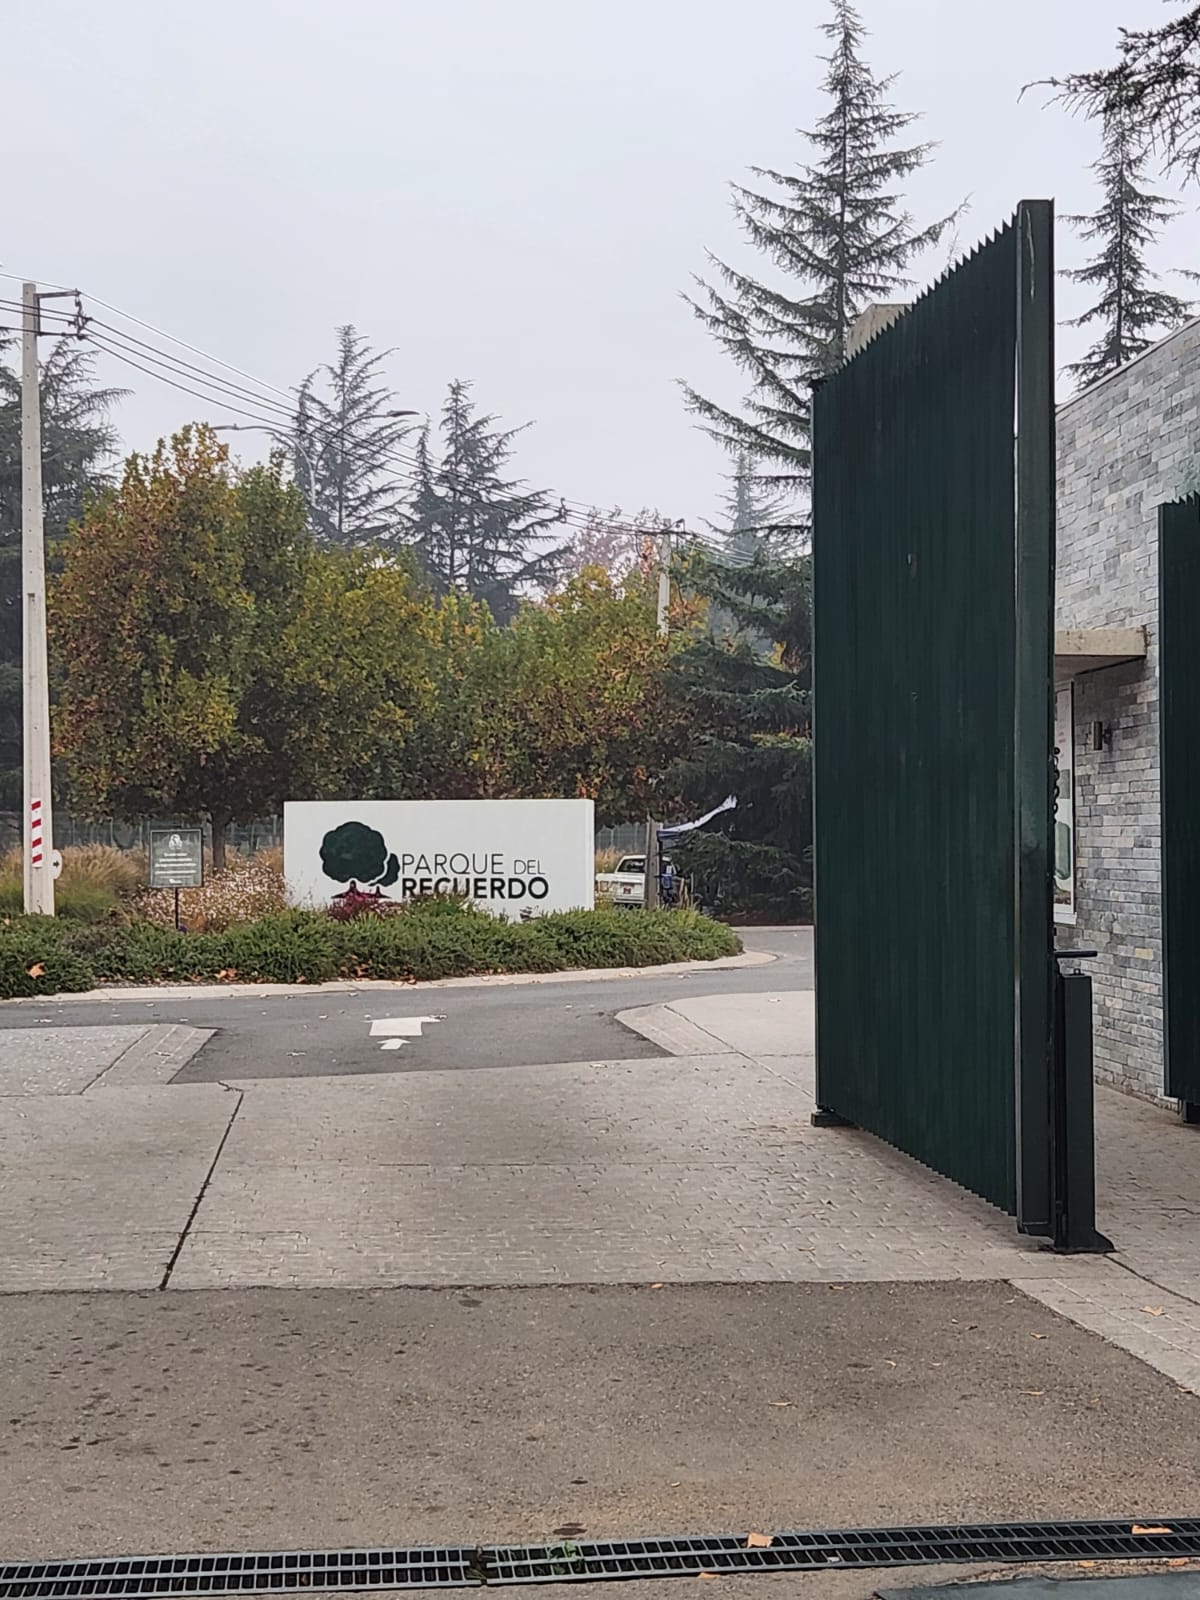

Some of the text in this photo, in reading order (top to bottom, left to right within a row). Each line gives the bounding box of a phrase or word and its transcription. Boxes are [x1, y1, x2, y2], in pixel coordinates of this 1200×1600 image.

[402, 853, 546, 875] PARQUE DEL
[401, 876, 549, 900] RECUERDO
